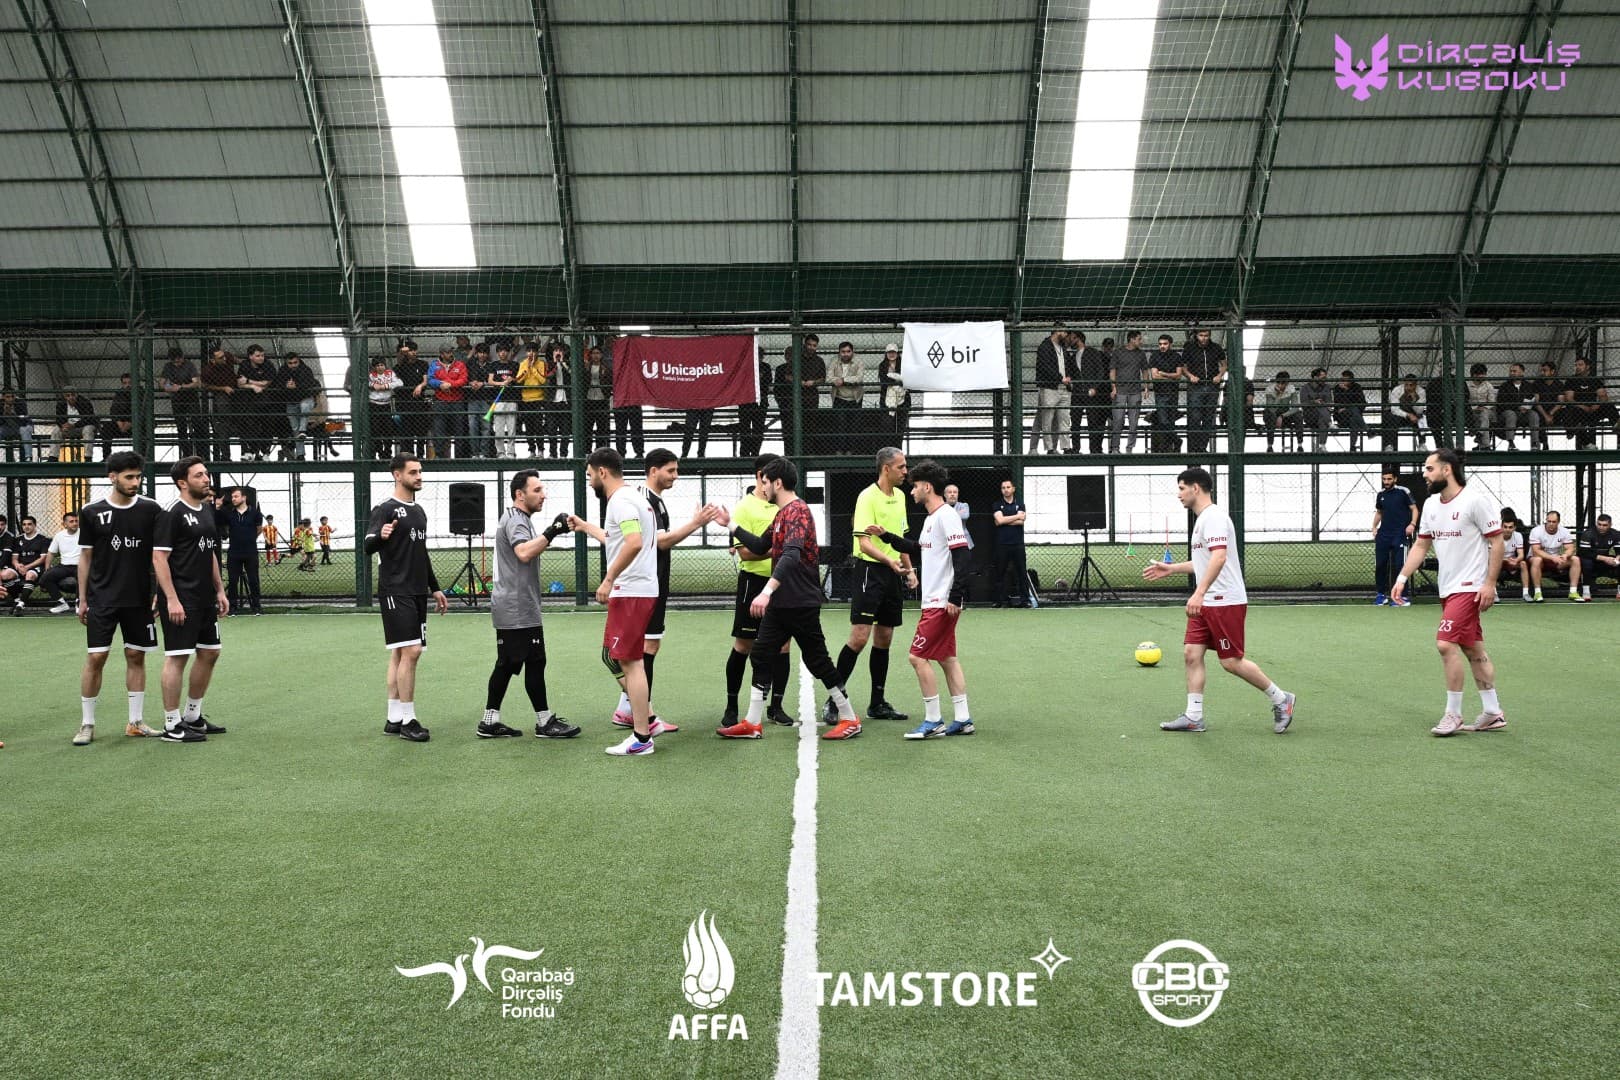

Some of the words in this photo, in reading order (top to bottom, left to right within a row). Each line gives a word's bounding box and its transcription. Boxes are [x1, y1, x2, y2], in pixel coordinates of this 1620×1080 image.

[951, 346, 980, 364] bir
[662, 362, 724, 379] Unicapital
[97, 510, 113, 525] 17
[184, 512, 199, 527] 14
[124, 536, 143, 548] bir
[1438, 619, 1454, 632] 23
[612, 637, 620, 649] 7
[912, 634, 927, 649] 22
[1219, 638, 1231, 650] 10
